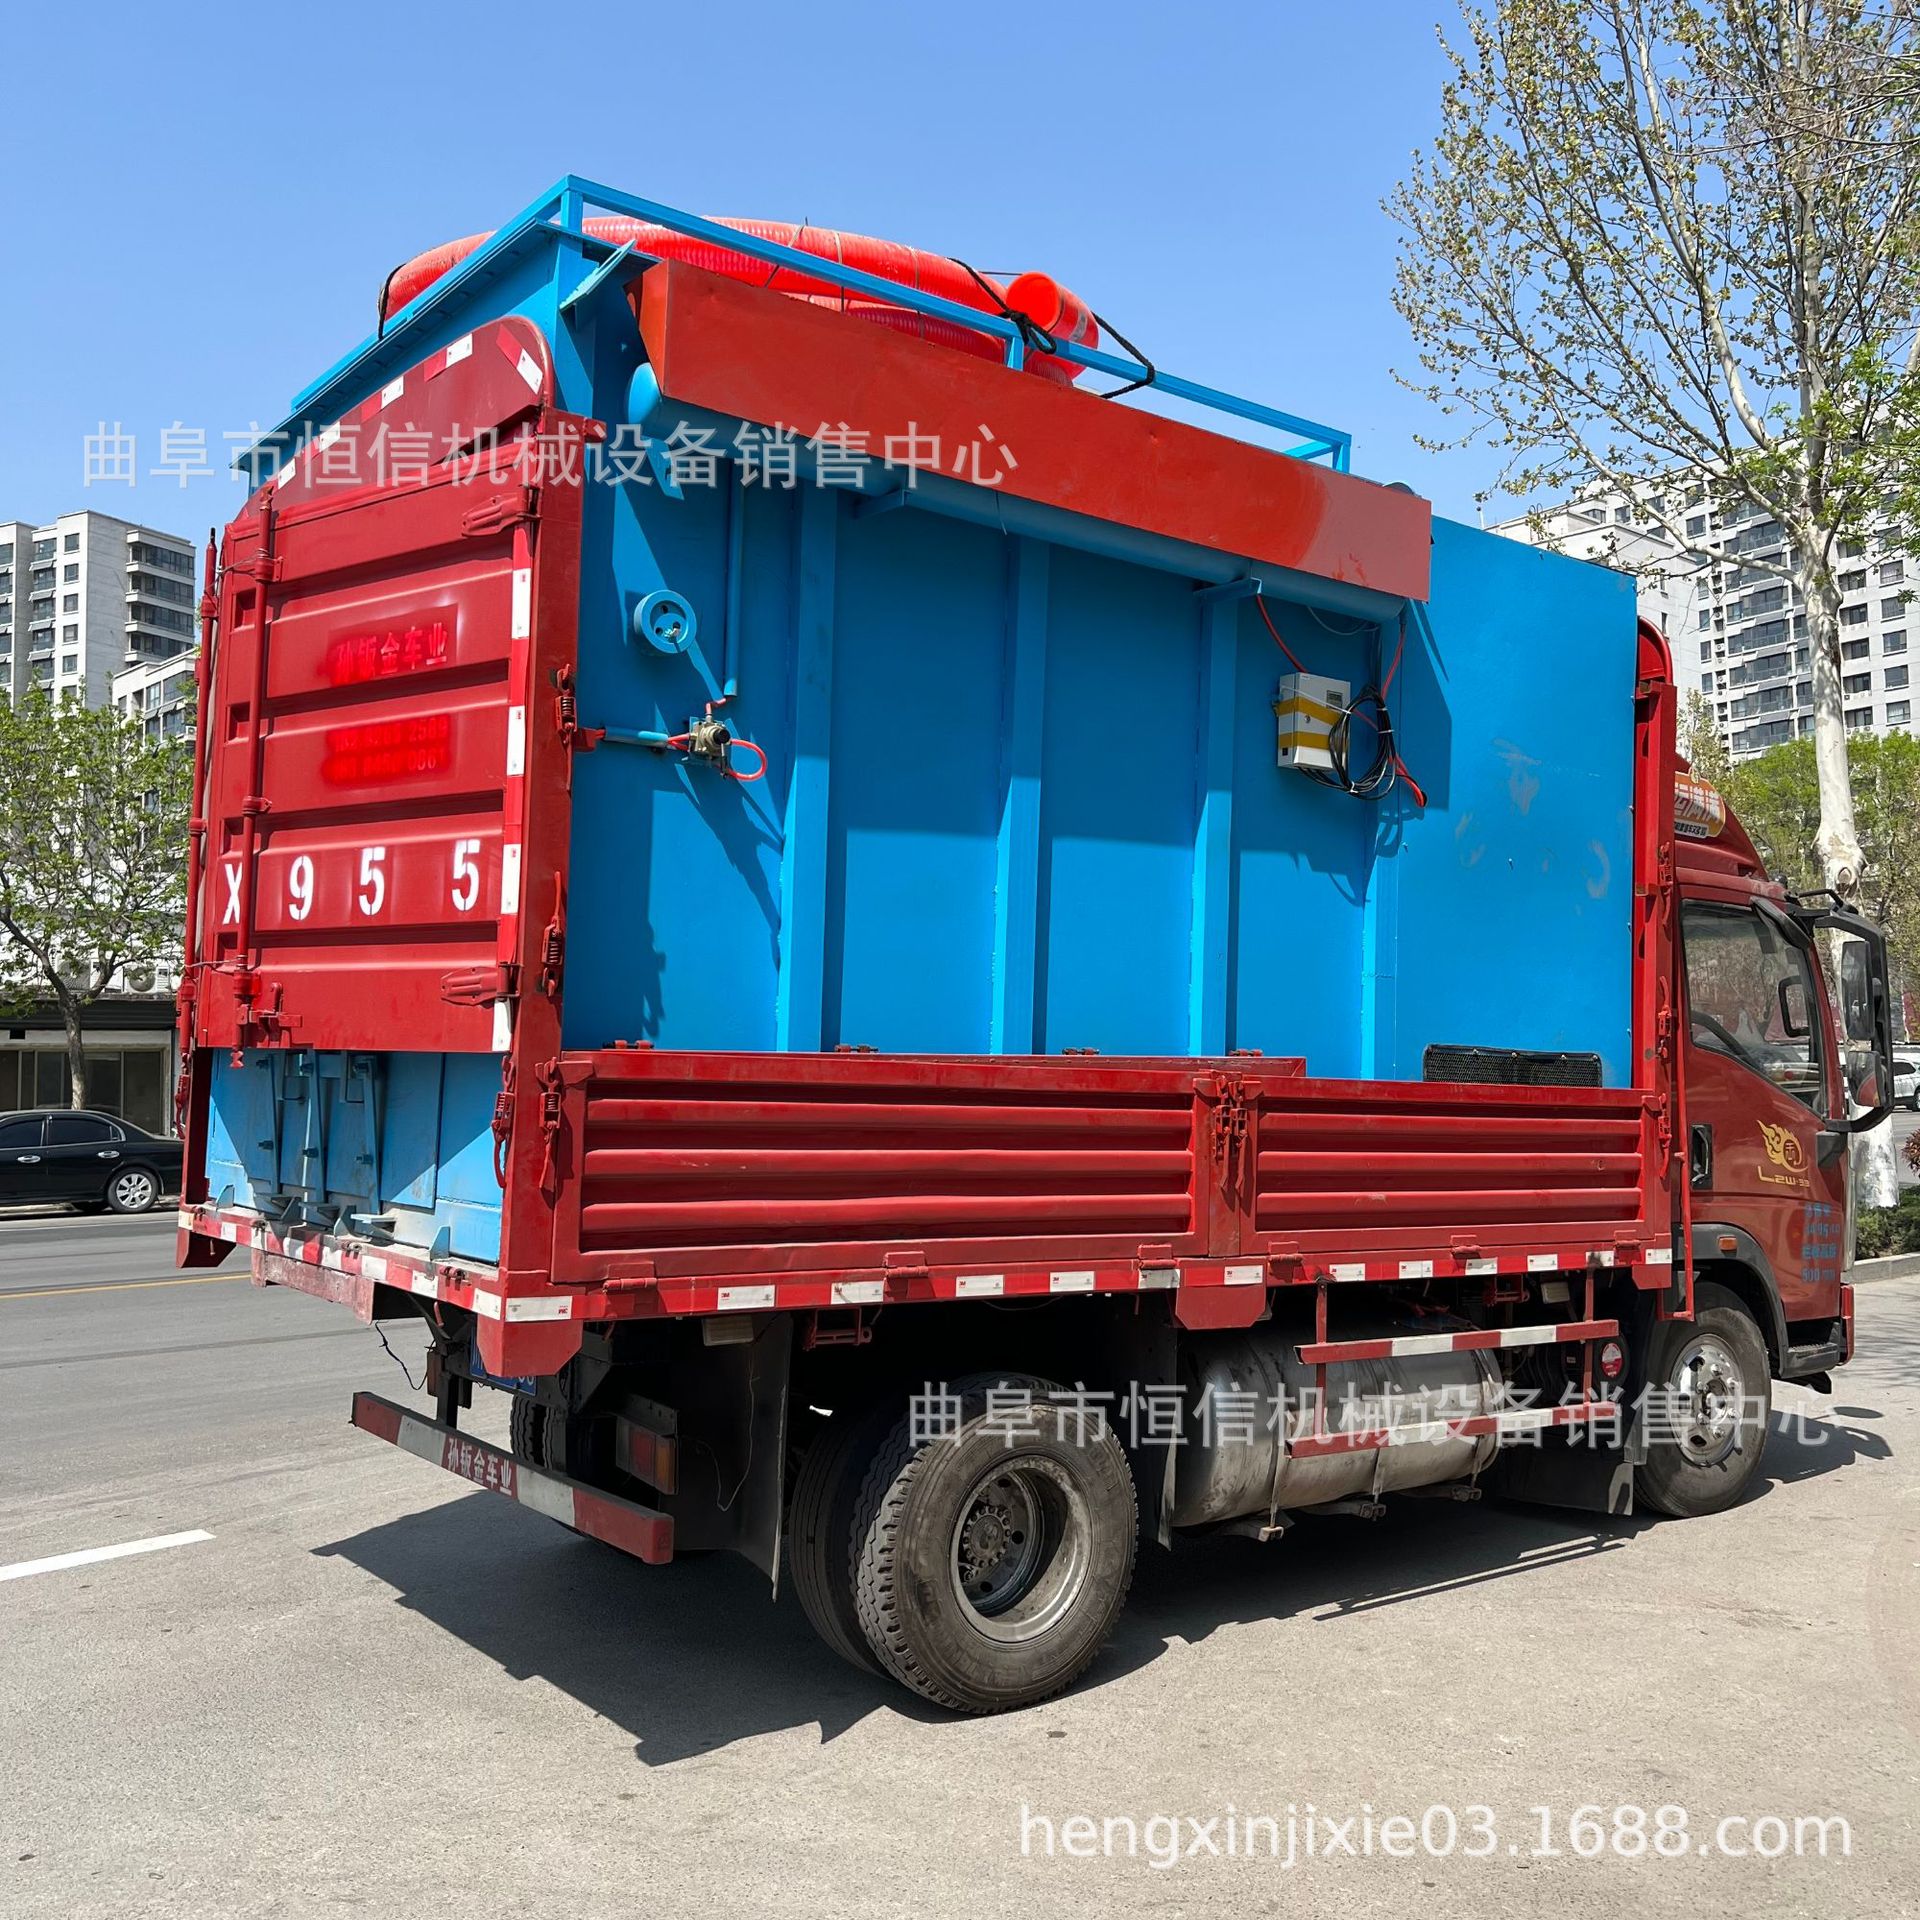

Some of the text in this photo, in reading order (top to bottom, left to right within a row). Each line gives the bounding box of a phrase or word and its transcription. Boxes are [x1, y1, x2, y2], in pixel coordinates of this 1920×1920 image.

[222, 839, 481, 925] X 9 5 5
